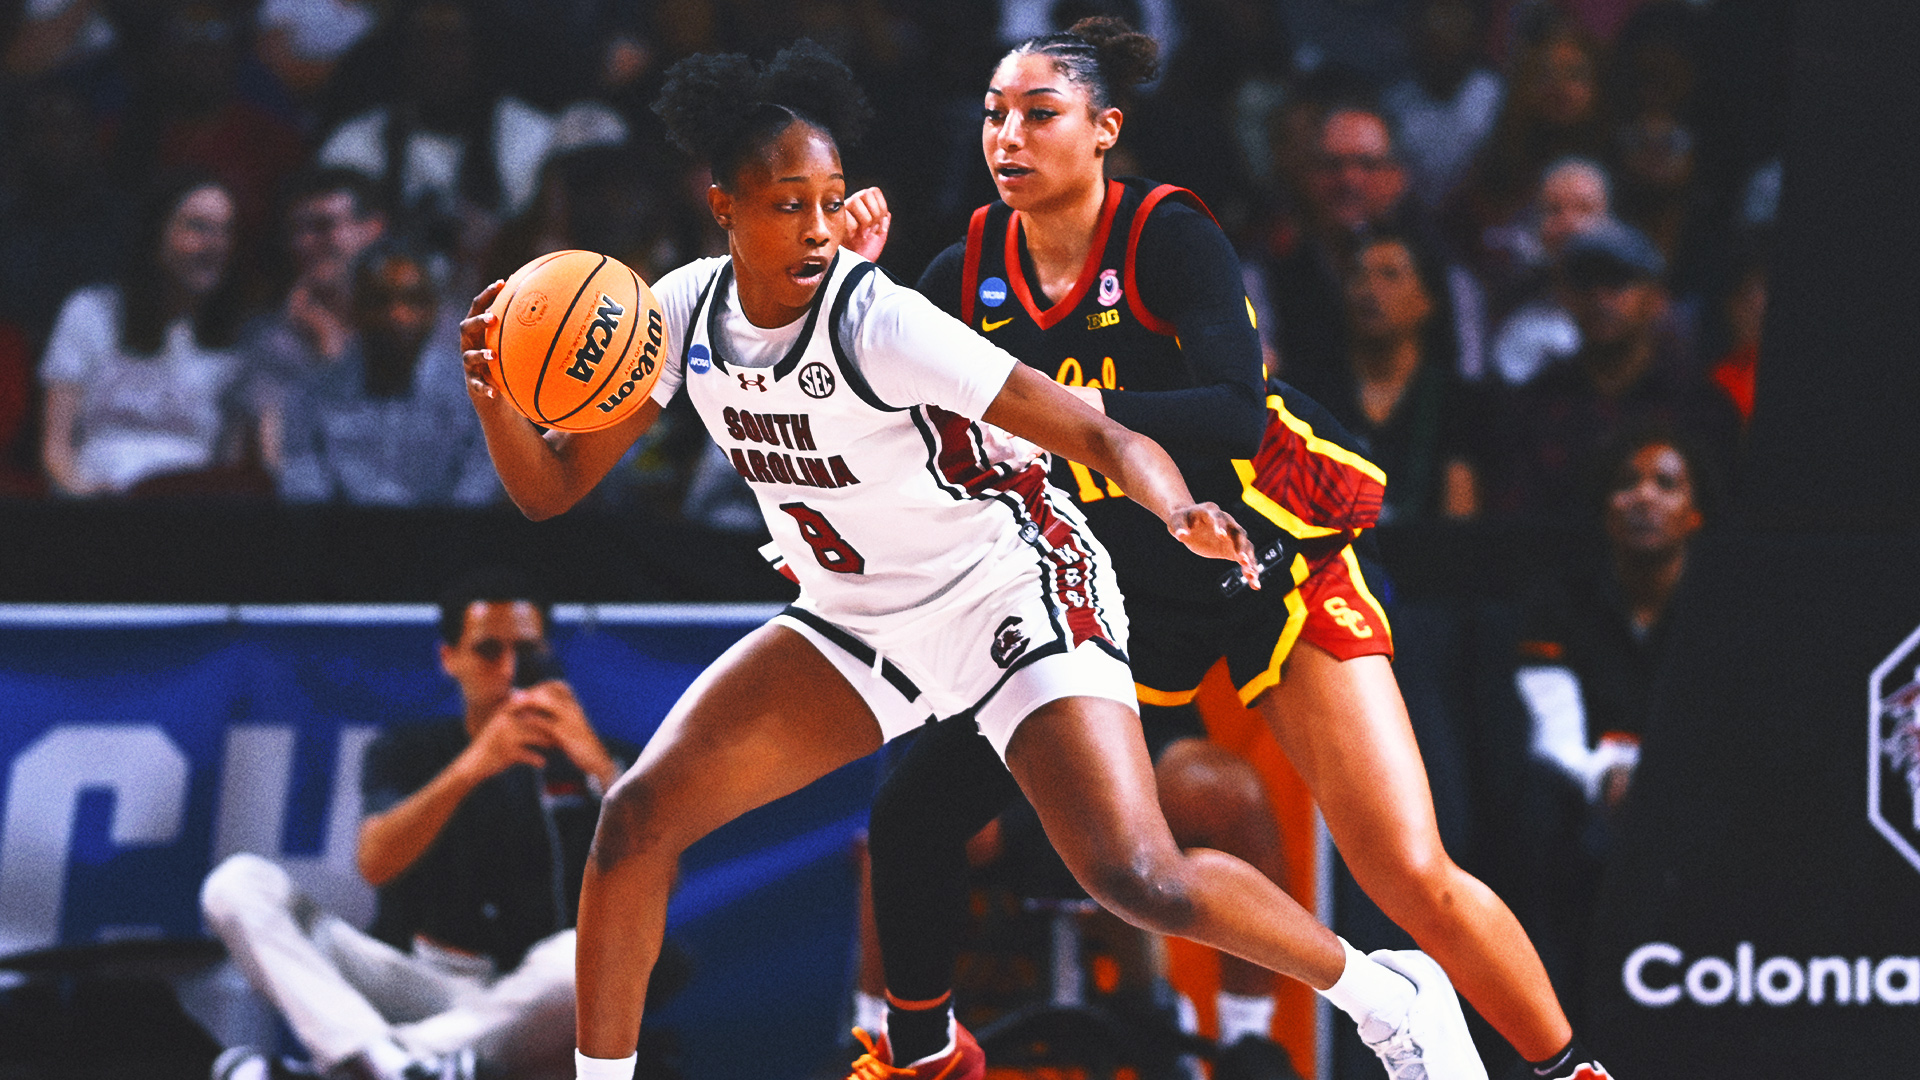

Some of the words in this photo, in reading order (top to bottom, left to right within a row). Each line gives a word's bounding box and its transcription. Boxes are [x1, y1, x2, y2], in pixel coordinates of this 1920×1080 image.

[565, 293, 626, 385] NCAA
[800, 363, 833, 397] SEC
[722, 405, 818, 451] SOUTH
[730, 448, 862, 489] AROLINA
[779, 501, 866, 576] 8
[1323, 596, 1373, 639] SC
